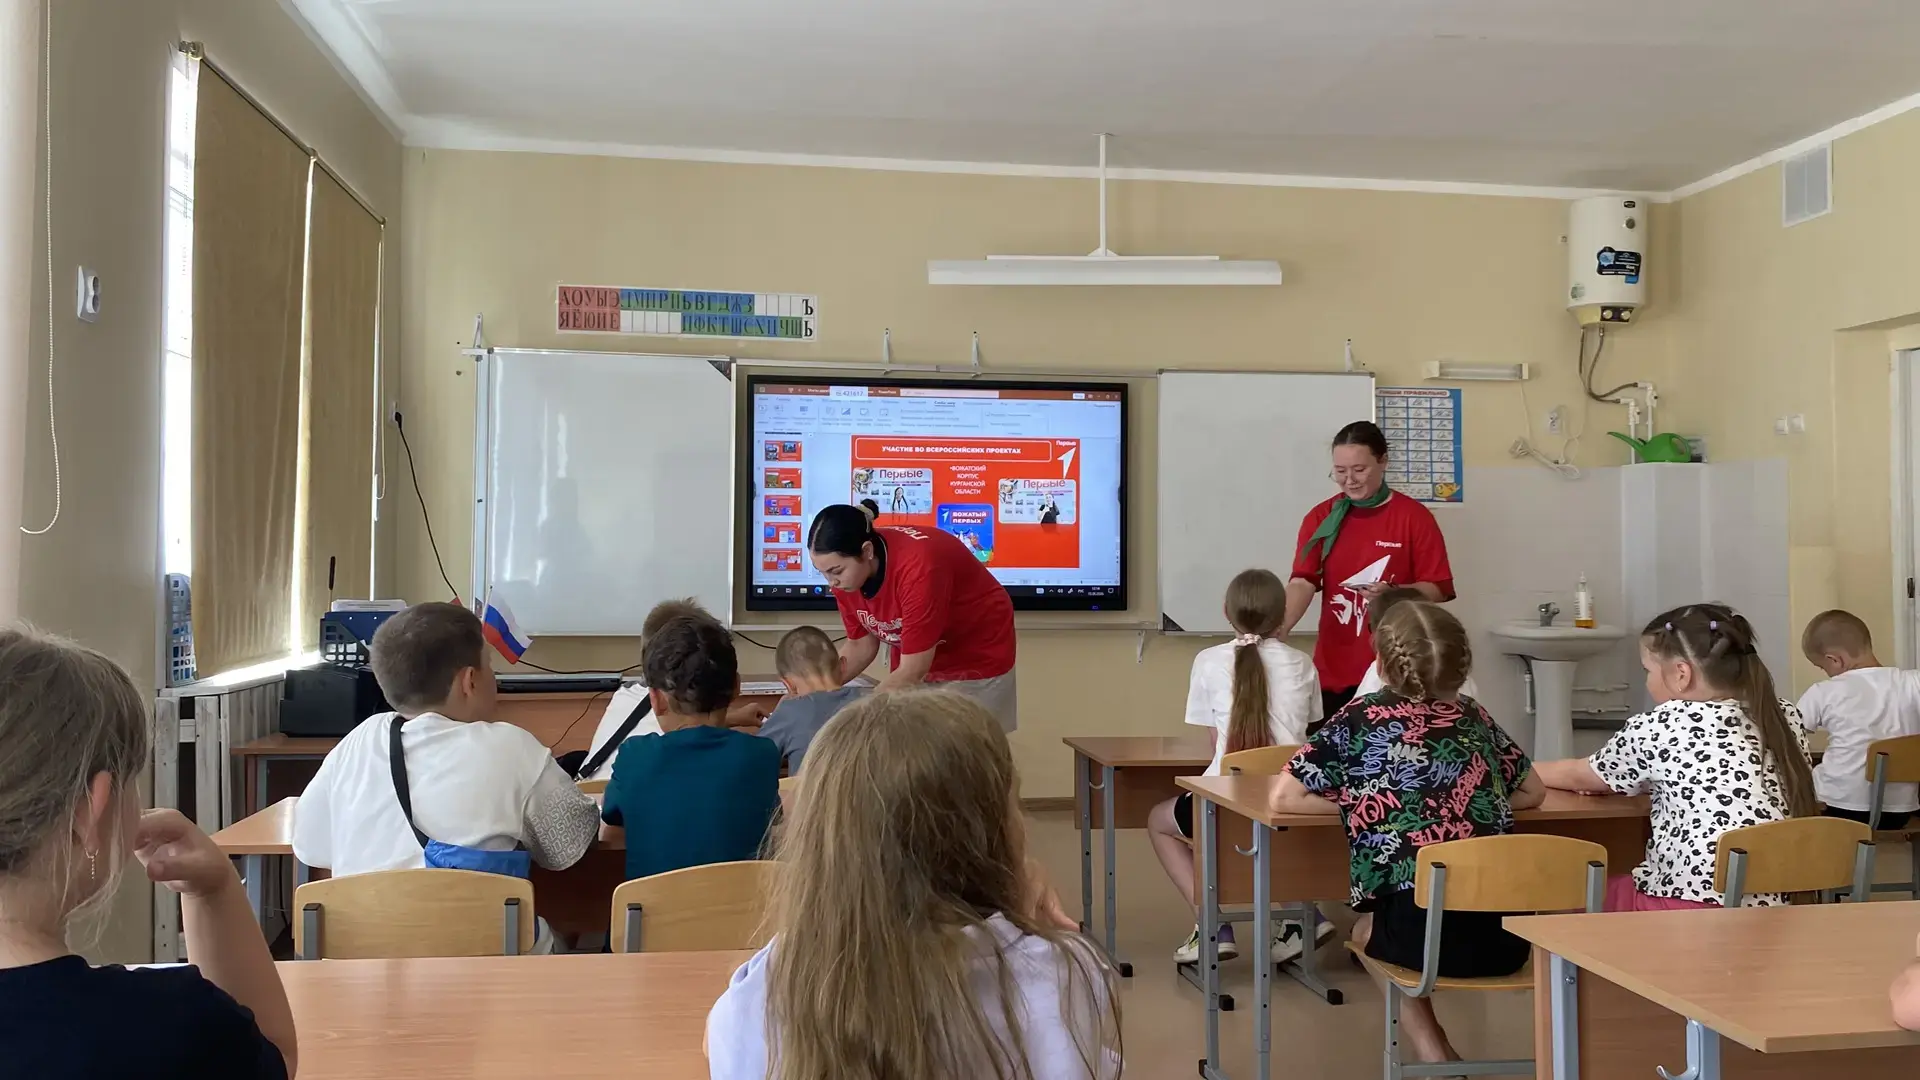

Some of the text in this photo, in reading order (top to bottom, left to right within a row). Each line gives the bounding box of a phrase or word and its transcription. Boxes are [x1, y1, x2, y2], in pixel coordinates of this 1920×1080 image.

[926, 446, 985, 454] ВСЕРОССИЙСКИХ
[879, 469, 924, 480] Первые
[1023, 480, 1066, 490] Первые
